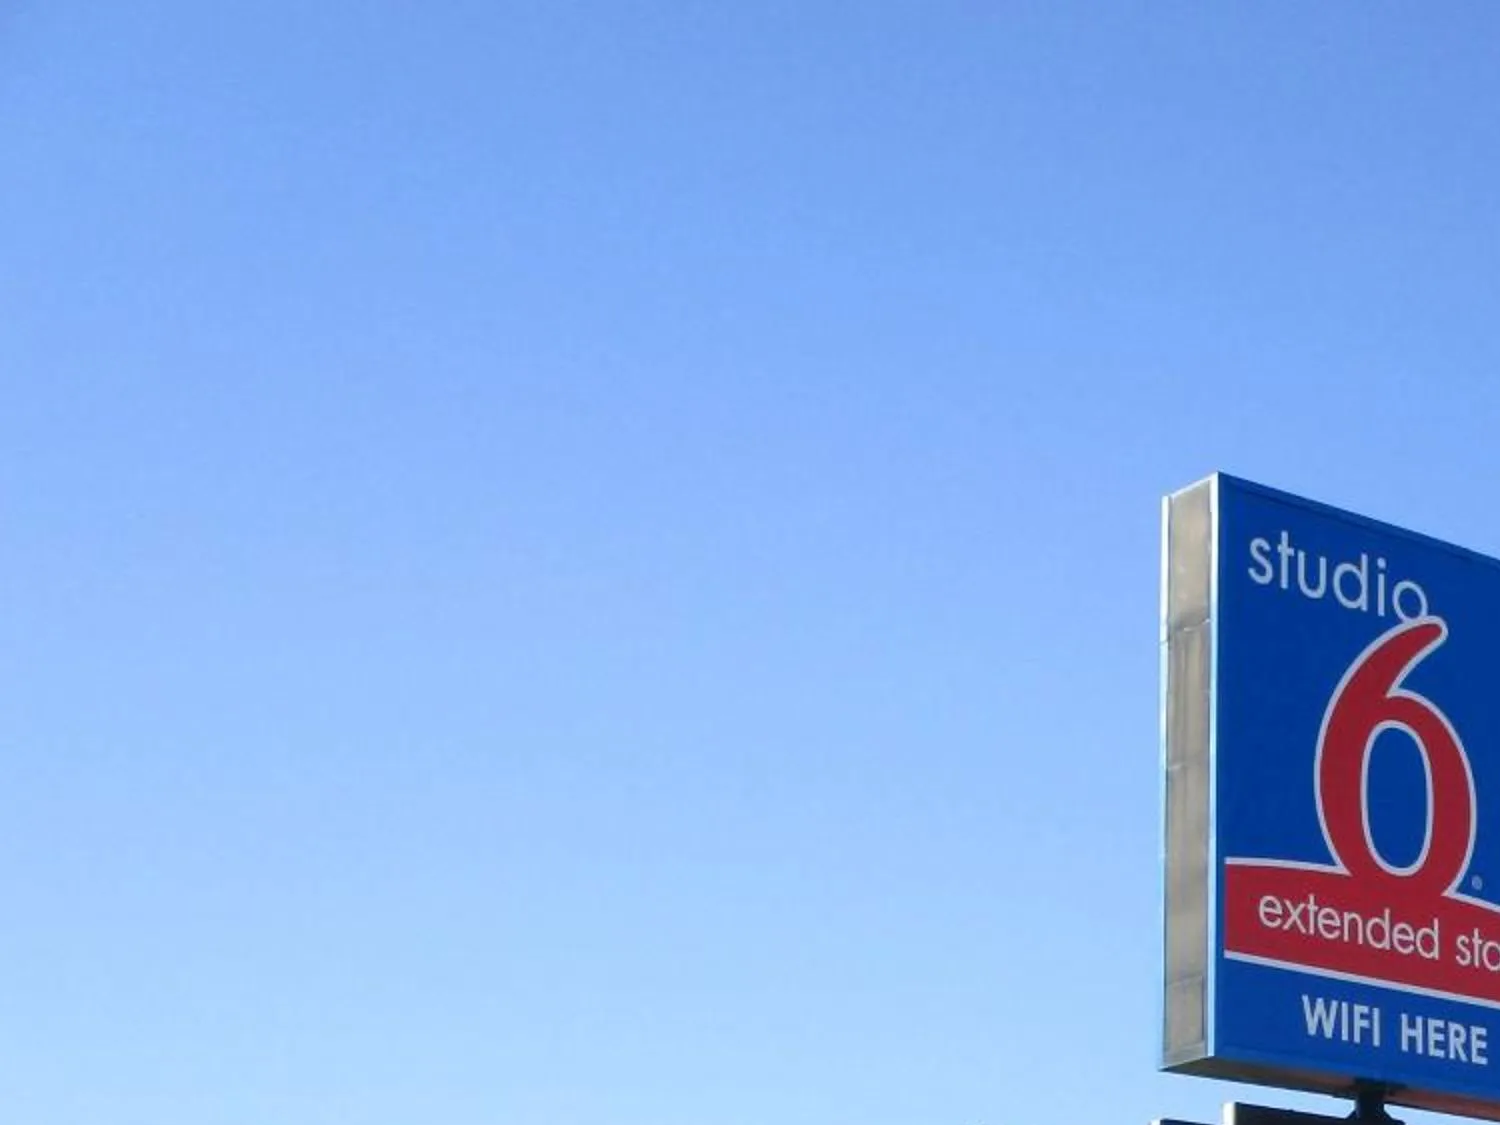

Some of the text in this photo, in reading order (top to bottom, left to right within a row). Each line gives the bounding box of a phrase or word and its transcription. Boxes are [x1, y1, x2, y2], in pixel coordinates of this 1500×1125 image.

[1247, 530, 1428, 623] studio
[1313, 614, 1477, 896] 6
[1258, 894, 1440, 961] extended
[1302, 994, 1489, 1066] WIFI HERE
